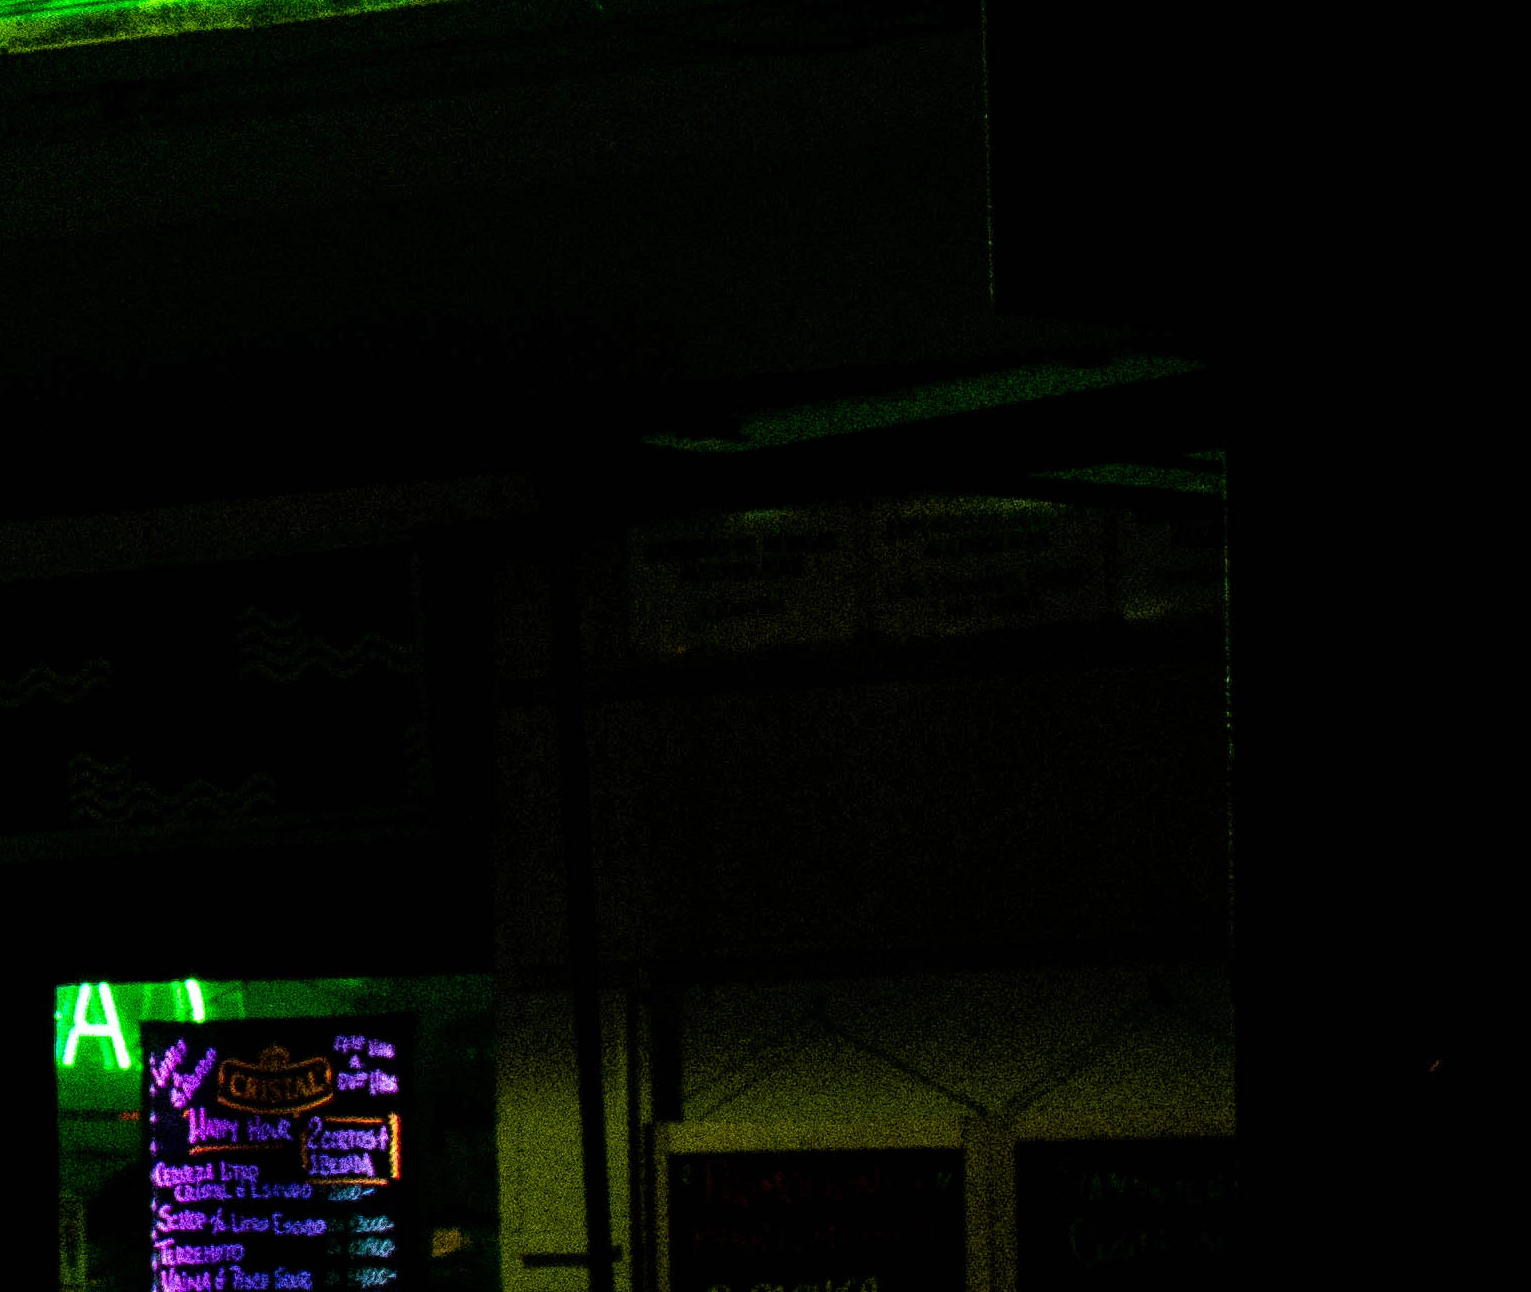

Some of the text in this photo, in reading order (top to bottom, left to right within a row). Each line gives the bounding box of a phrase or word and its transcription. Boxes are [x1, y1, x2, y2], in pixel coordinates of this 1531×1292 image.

[227, 1068, 326, 1104] CRISTAL
[184, 1106, 293, 1144] HAPPY HOUR
[154, 1238, 245, 1266] TERREMOTO
